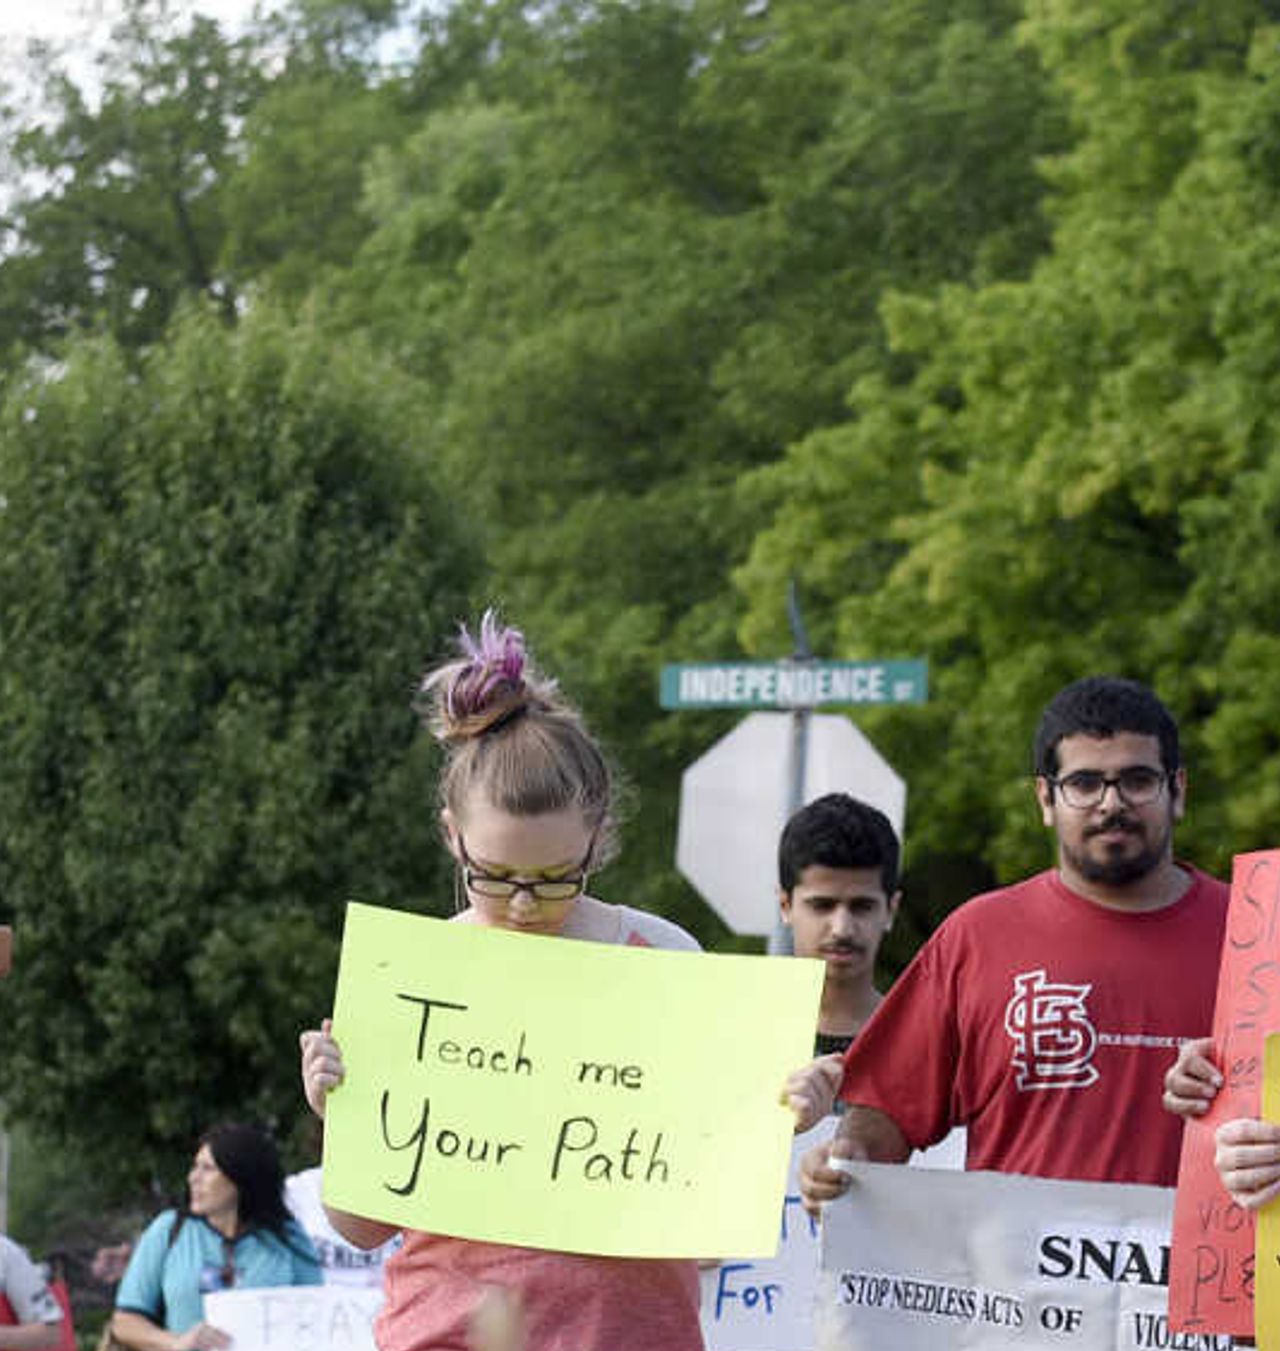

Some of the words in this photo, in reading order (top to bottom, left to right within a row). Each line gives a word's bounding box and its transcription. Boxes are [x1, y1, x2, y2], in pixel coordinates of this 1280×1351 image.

[678, 667, 885, 701] INDEPENDENCE
[397, 993, 534, 1076] Teach
[577, 1060, 644, 1089] me
[380, 1090, 524, 1197] Your
[716, 1264, 780, 1320] For
[892, 1278, 977, 1319] NEEDLESS
[982, 1294, 1024, 1328] ACTS
[1041, 1305, 1083, 1333] OF
